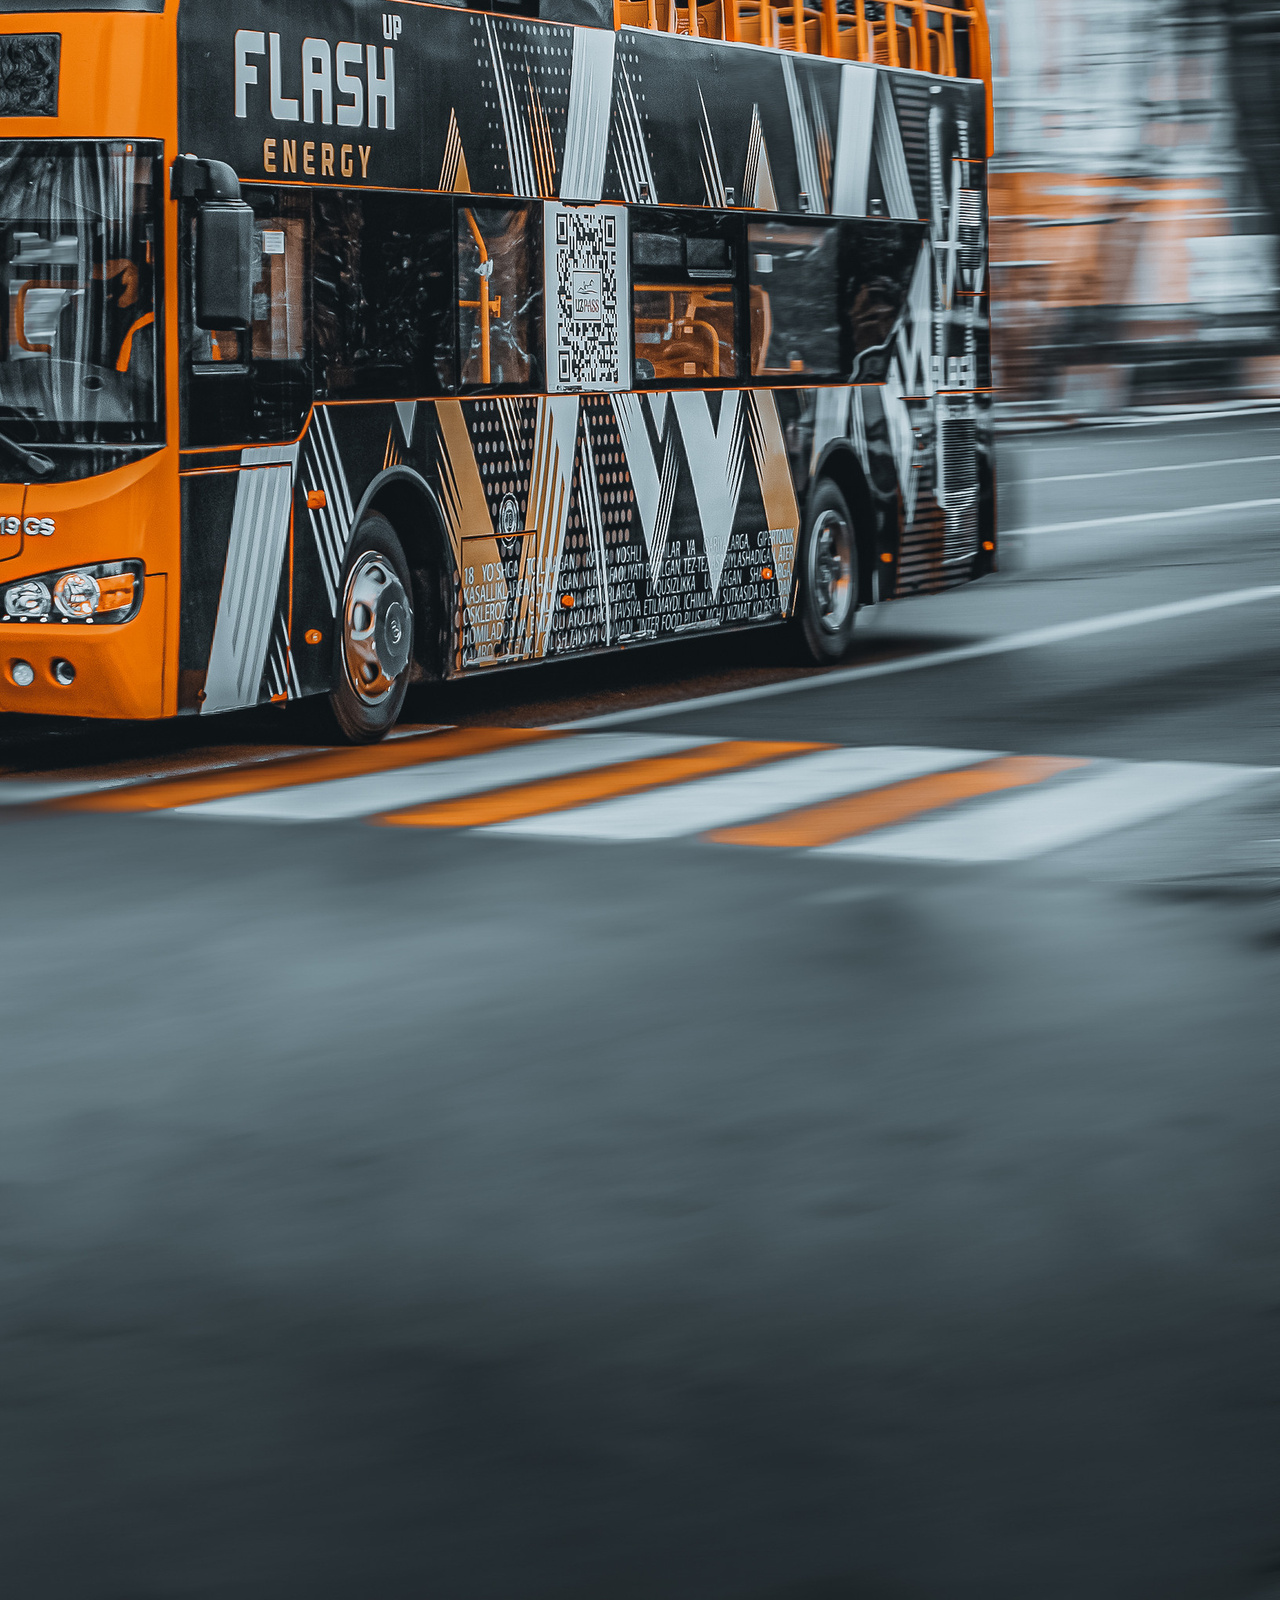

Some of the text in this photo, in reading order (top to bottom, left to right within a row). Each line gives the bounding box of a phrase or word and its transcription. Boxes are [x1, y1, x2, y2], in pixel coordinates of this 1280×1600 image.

[382, 14, 402, 40] UP
[235, 29, 395, 130] FLASH
[263, 138, 371, 178] ENERGY
[464, 566, 474, 585] 18
